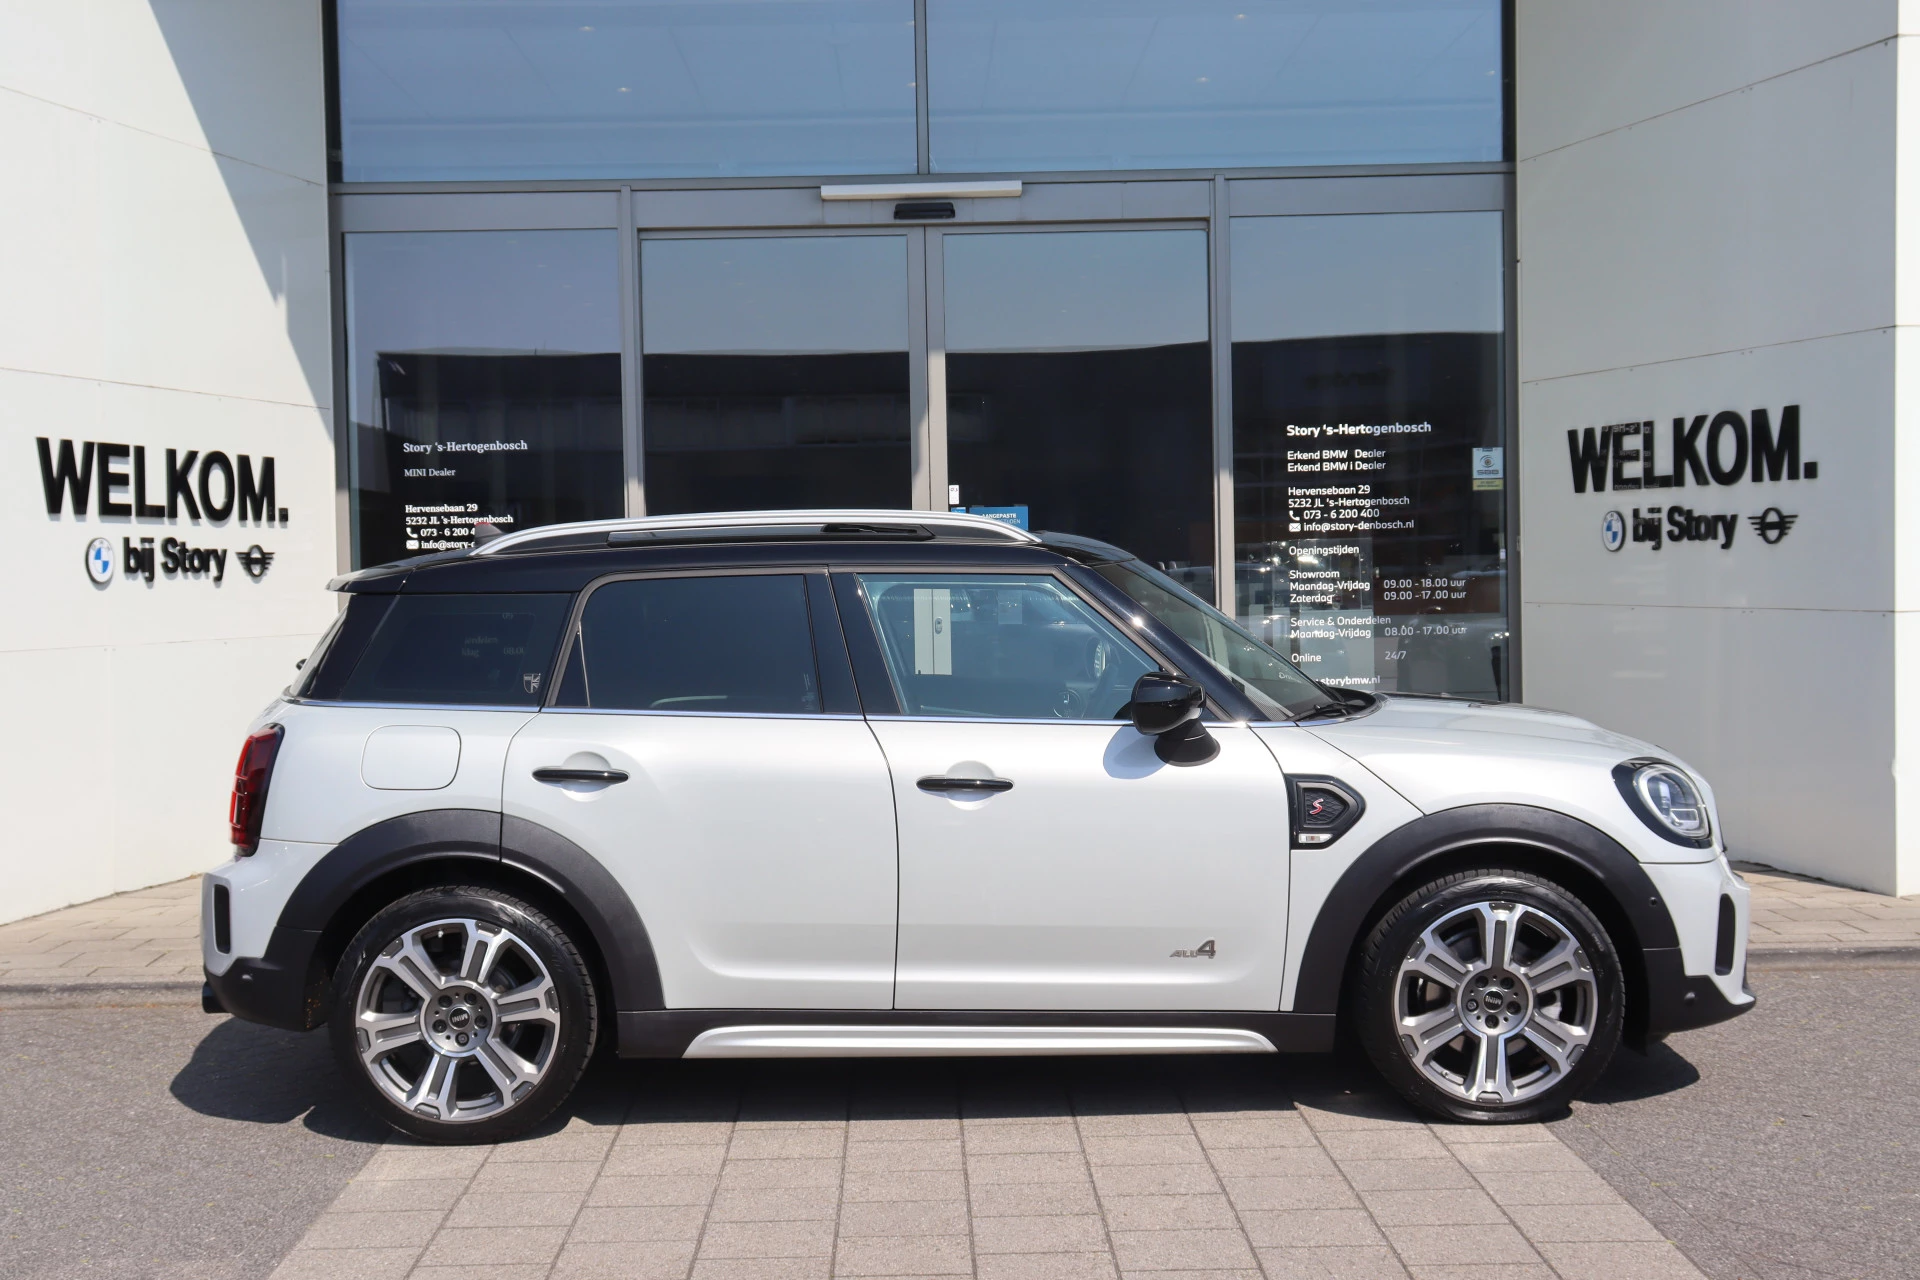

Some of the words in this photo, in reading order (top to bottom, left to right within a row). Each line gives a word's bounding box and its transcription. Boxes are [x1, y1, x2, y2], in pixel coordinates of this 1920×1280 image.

[1286, 424, 1320, 438] Story
[403, 442, 432, 454] Story
[1567, 405, 1818, 493] WELKOM.
[1287, 450, 1320, 460] Erkend
[1322, 450, 1348, 459] BMW
[1354, 448, 1386, 458] Dealer
[404, 468, 426, 477] MINI
[428, 467, 456, 476] Dealer
[1287, 462, 1320, 472] Erkend
[1322, 462, 1348, 471] BMW
[1350, 462, 1353, 470] i
[1355, 461, 1386, 470] Dealer
[36, 437, 288, 522] WELKOM.
[1288, 486, 1356, 496] Hervensebaan
[1358, 485, 1371, 494] 29
[405, 504, 464, 513] Hervensebaan
[466, 504, 478, 512] 29
[1288, 498, 1312, 508] 5232
[1314, 498, 1324, 507] JL
[1304, 510, 1321, 519] 073
[1330, 510, 1337, 518] 6
[1338, 509, 1358, 518] 200
[1360, 509, 1380, 518] 400
[406, 516, 427, 525] 5232
[429, 516, 439, 525] JL
[1304, 520, 1414, 532] info@story-denbosch.nl
[420, 528, 437, 536] 073
[444, 528, 450, 536] 6
[452, 528, 468, 536] 200
[1632, 507, 1662, 550] bij
[1666, 506, 1738, 550] Story
[1289, 545, 1360, 556] Openingstijden
[123, 537, 155, 582] bij
[161, 537, 228, 582] Story
[1289, 570, 1340, 579] Showroom
[1290, 580, 1371, 592] Maandag-Vrijdag
[1384, 579, 1412, 589] 09.00
[1421, 578, 1448, 588] 18.00
[1450, 579, 1466, 587] uur
[1290, 594, 1333, 604] Zaterdag
[1384, 591, 1413, 601] 09.00
[1451, 591, 1467, 599] uur
[1290, 617, 1325, 627] Service
[1327, 617, 1335, 626] &
[1337, 616, 1391, 626] Onderdelen
[1291, 628, 1372, 640] Maandag-Vrijdag
[1384, 627, 1413, 636] 08.00
[1452, 627, 1468, 635] uur
[1292, 653, 1322, 662] Online
[1384, 651, 1406, 660] 24/7
[1320, 675, 1381, 686] storybmw.nl
[1310, 798, 1324, 815] S
[452, 1013, 468, 1023] MINI
